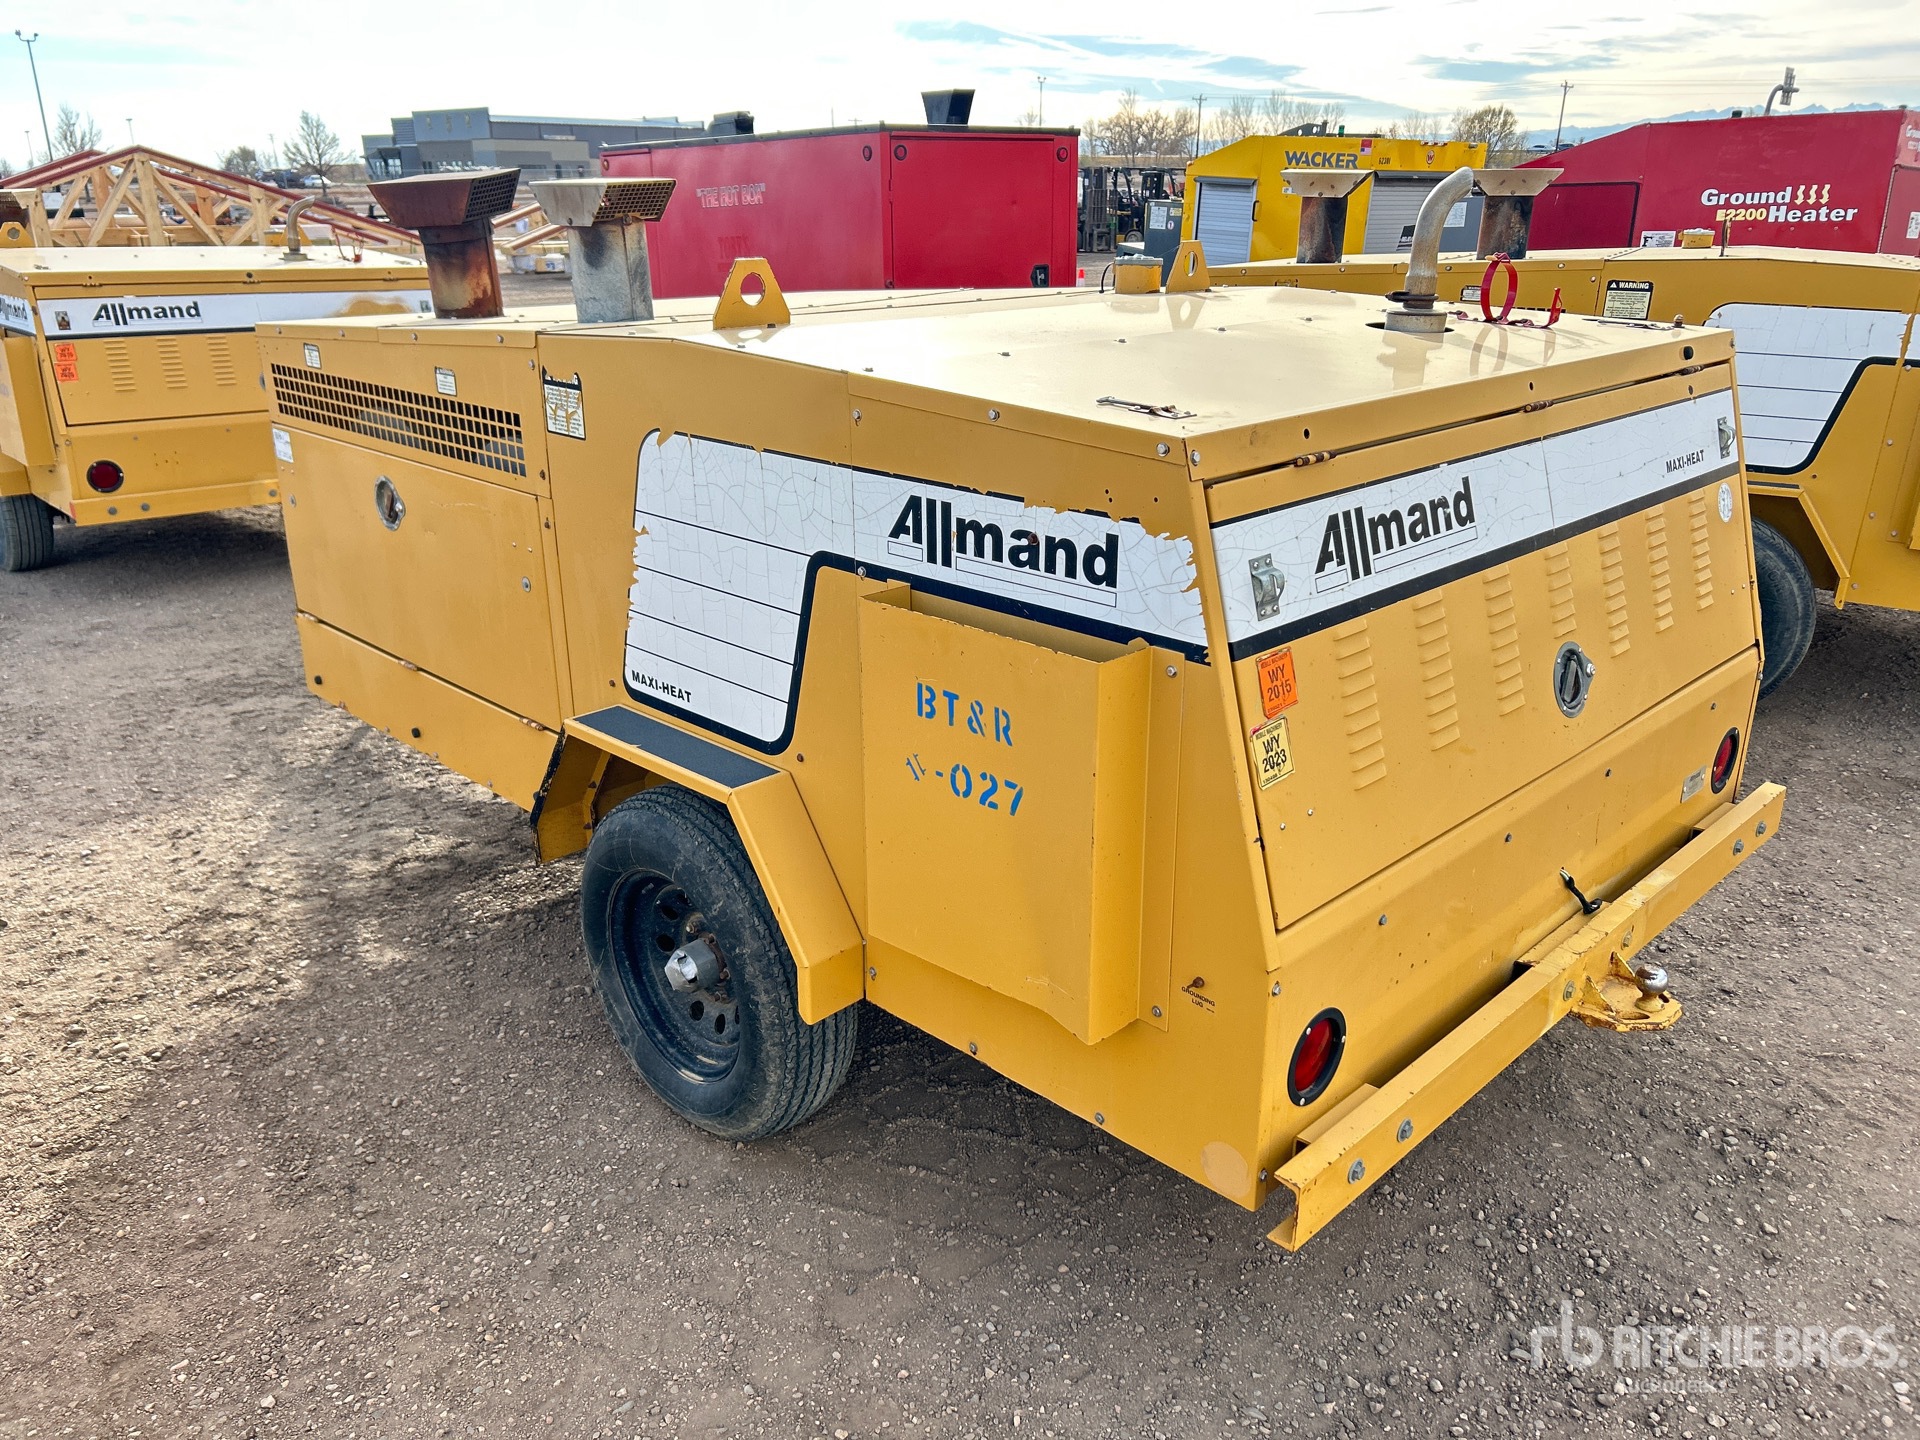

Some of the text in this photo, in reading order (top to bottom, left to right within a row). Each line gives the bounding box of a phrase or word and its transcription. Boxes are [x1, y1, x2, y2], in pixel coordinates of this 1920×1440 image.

[1285, 151, 1358, 169] WACKER
[1701, 187, 1792, 206] Ground
[1715, 206, 1858, 222] E2200 Heater
[1619, 281, 1649, 290] WARNING
[92, 301, 201, 326] Allmand
[1665, 449, 1704, 474] MAXI-HEAT
[1315, 476, 1475, 581] Allmand
[888, 494, 1119, 589] Allmand
[1267, 663, 1285, 683] WY
[632, 669, 691, 703] MAXI-HEAT
[1267, 679, 1292, 702] 2015
[1262, 733, 1280, 755] WY
[1262, 748, 1287, 774] 2023
[1182, 986, 1216, 1007] GROUNDING
[1191, 998, 1204, 1008] LUG
